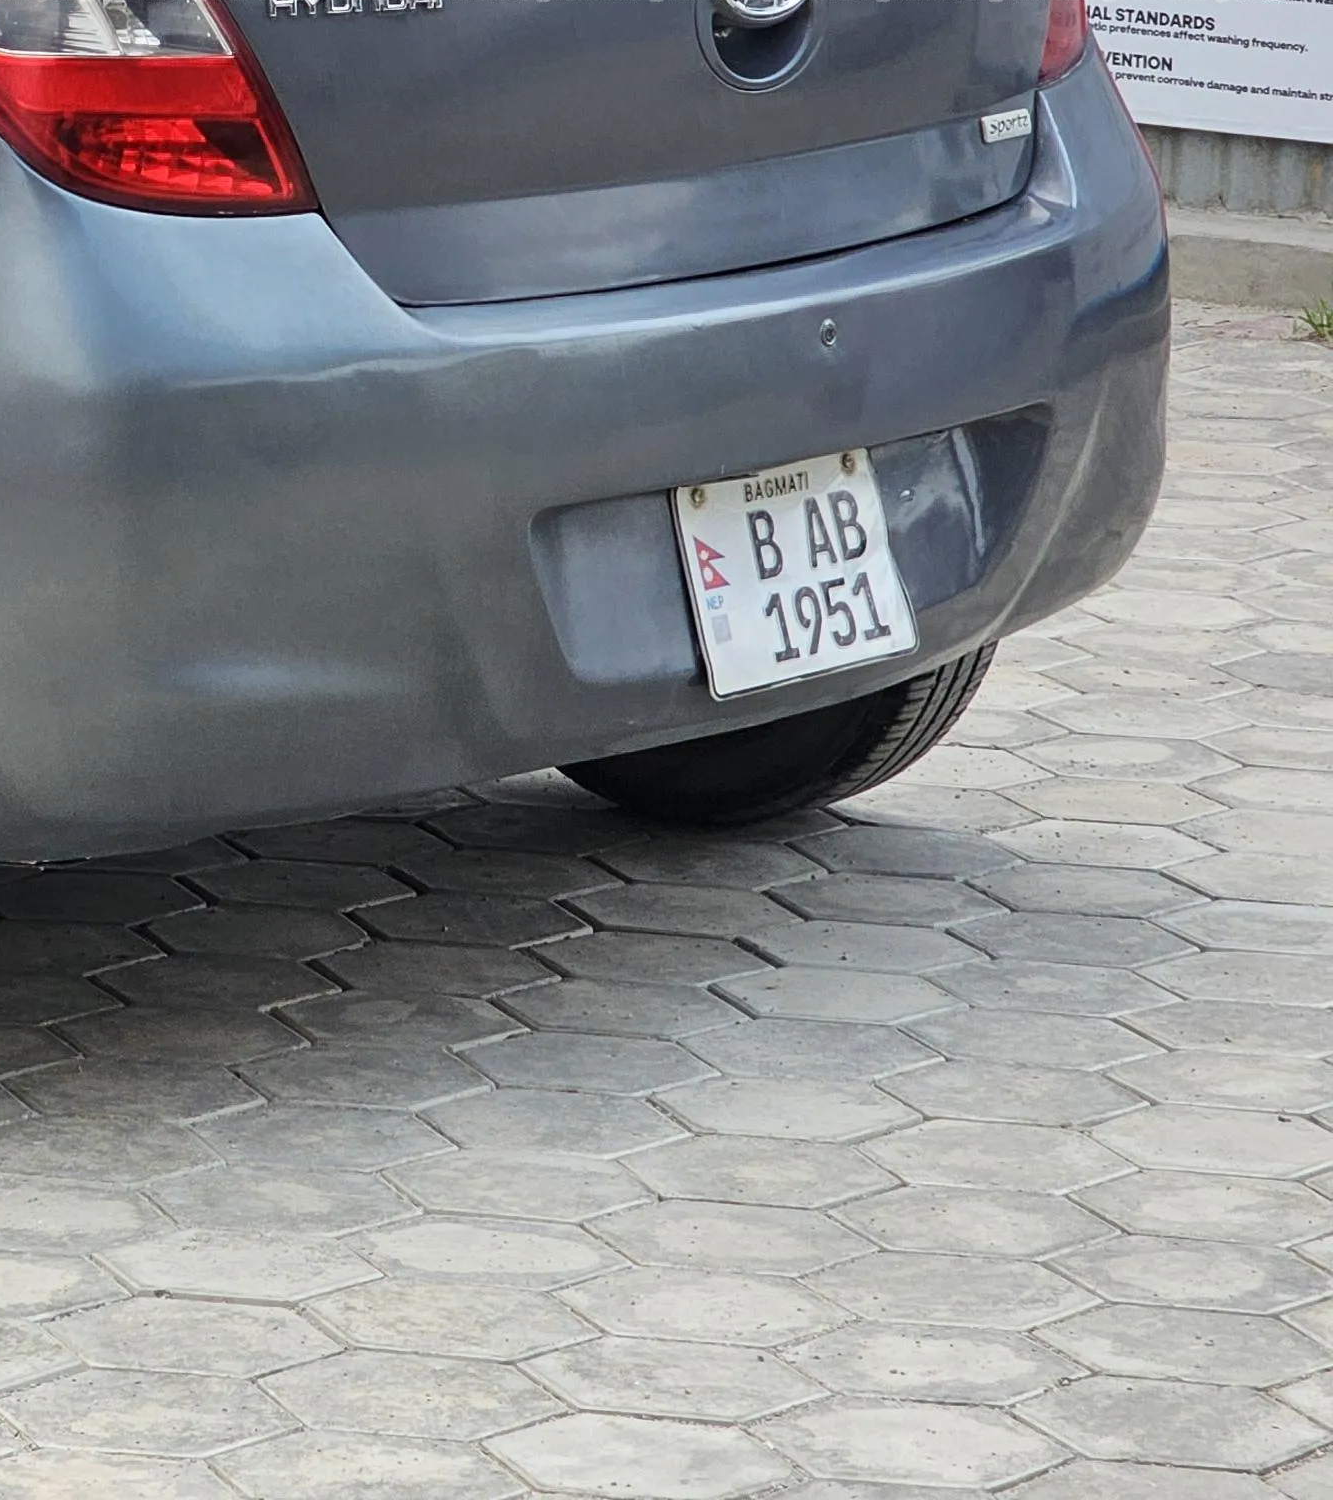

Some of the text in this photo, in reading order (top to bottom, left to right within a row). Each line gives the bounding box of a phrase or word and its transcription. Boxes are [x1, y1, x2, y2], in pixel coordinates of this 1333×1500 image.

[1115, 8, 1215, 31] STANDARDS
[1109, 24, 1171, 38] preferences
[1173, 30, 1205, 42] affect
[1207, 34, 1250, 48] washing
[1252, 38, 1308, 54] frequency.
[1115, 71, 1155, 83] prevent
[1157, 75, 1205, 88] corrosive
[1207, 80, 1248, 94] damage
[1250, 86, 1270, 95] and
[1272, 87, 1318, 100] maintain
[743, 471, 809, 503] BAGMATI
[746, 489, 868, 580] B AB
[705, 595, 724, 610] NEP
[764, 572, 891, 663] 1951
